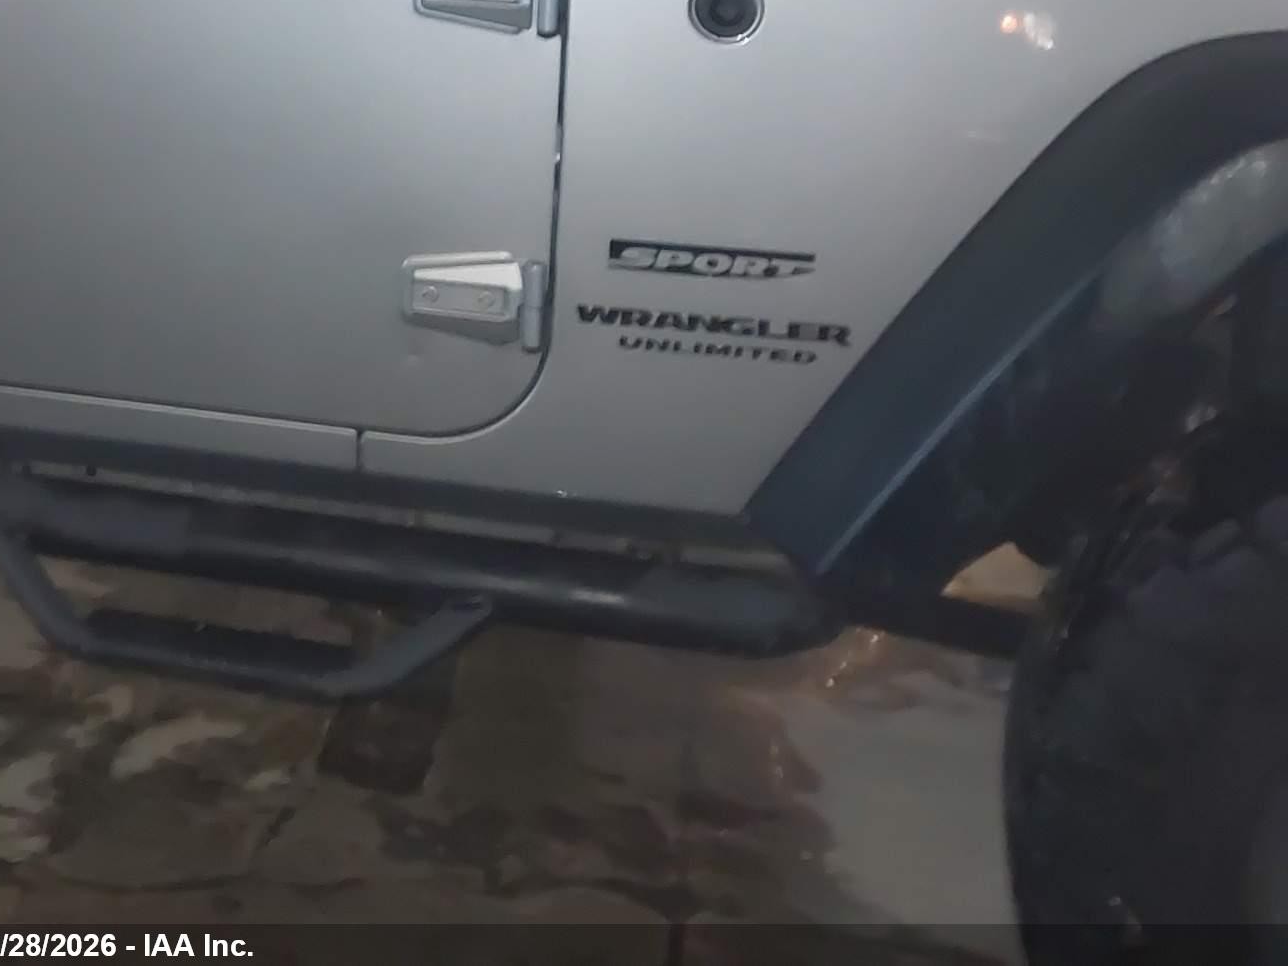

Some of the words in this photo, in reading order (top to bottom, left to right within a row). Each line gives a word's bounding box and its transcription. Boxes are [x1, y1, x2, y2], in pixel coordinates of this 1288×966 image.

[611, 246, 816, 277] SPORT
[577, 303, 852, 346] WRANGLER
[618, 335, 818, 365] UNLIMITED
